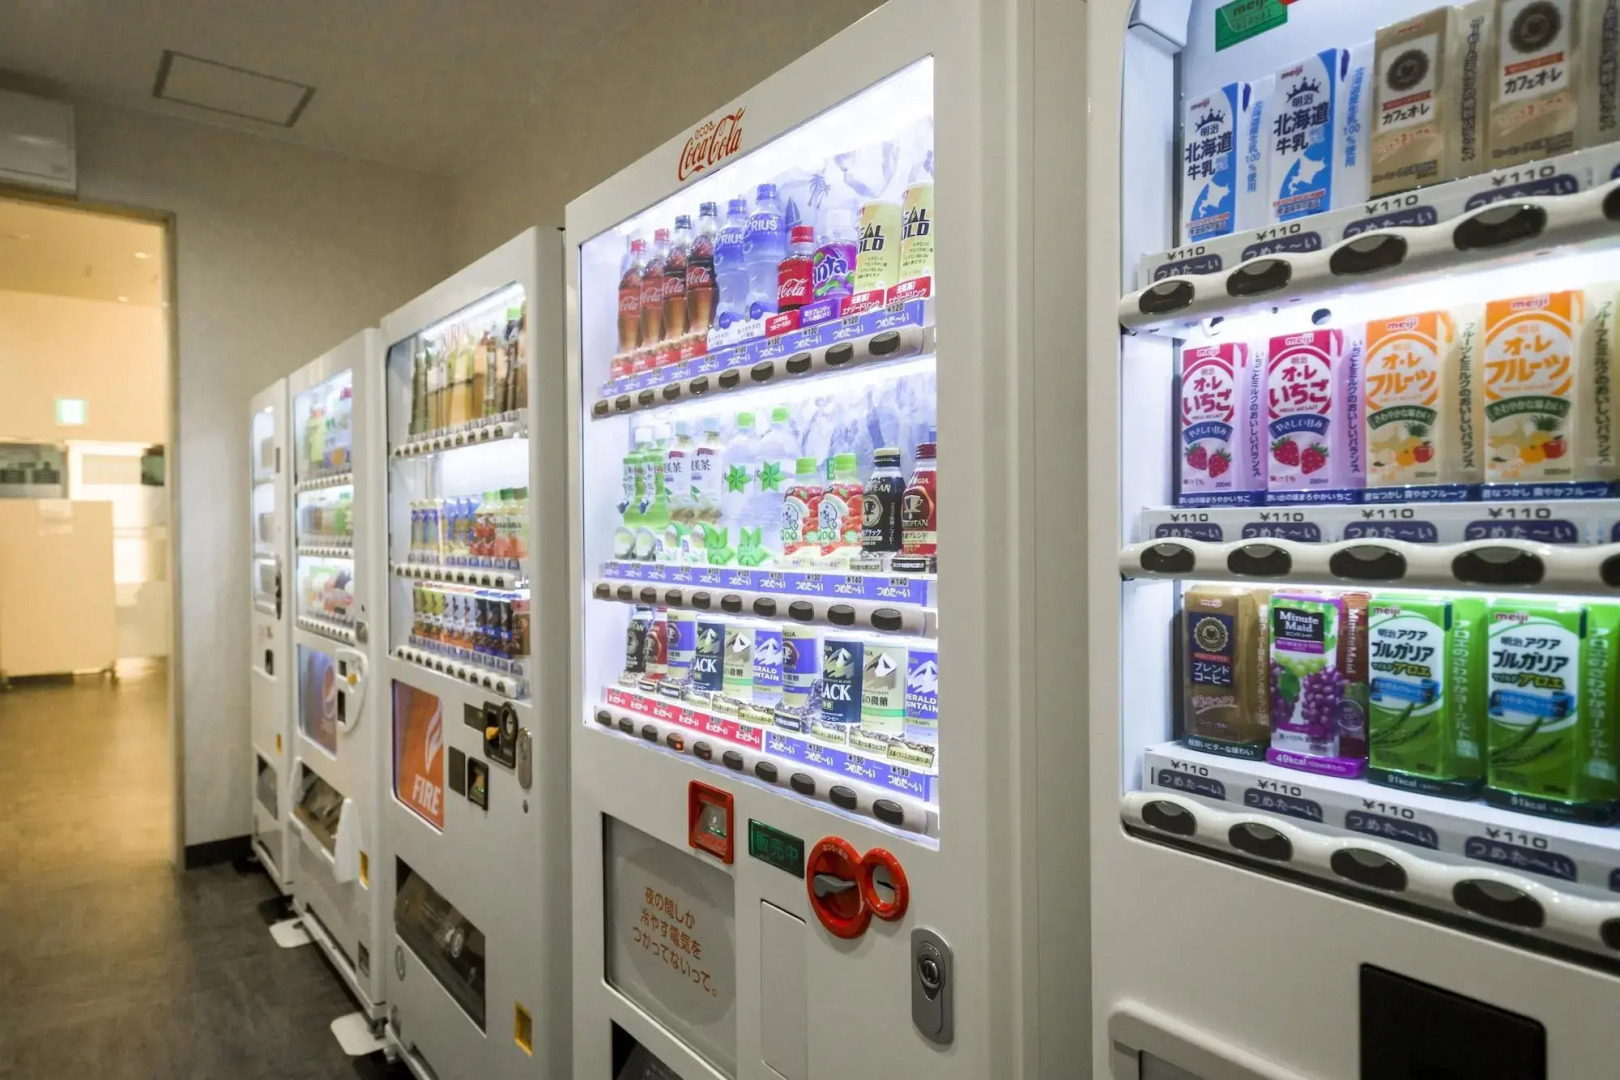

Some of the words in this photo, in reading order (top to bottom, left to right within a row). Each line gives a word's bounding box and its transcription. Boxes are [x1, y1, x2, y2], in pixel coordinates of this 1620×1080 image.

[1281, 65, 1304, 79] meiji
[1291, 93, 1314, 107] 明治
[1274, 101, 1330, 137] 北海道
[1200, 124, 1219, 137] 明治
[678, 105, 747, 181] Coca-Cola
[1185, 131, 1233, 164] 北海道
[1276, 137, 1309, 156] 牛乳
[1187, 159, 1216, 181] 牛乳
[1491, 164, 1556, 187] ¥110
[1364, 194, 1419, 215] ¥110
[1256, 223, 1301, 242] ¥110
[1167, 246, 1206, 261] ¥110
[687, 266, 711, 285] Cola
[662, 277, 685, 296] Cola
[777, 278, 809, 300] Cola
[620, 296, 640, 312] Cola
[1511, 296, 1550, 309] meiji
[875, 313, 910, 328] つめた～い
[1387, 318, 1419, 331] meiji
[833, 325, 864, 339] つめた～い
[1285, 333, 1314, 346] meiji
[794, 335, 822, 349] つめた～い
[1503, 335, 1552, 354] オ・レ
[1196, 345, 1220, 357] meiji
[1382, 353, 1422, 370] オ・レ
[1485, 354, 1570, 385] フルーツ
[1282, 365, 1318, 382] オ・レ
[1193, 376, 1223, 392] オ・レ
[1367, 370, 1437, 398] フルーツ
[1269, 379, 1330, 407] いちご
[1183, 389, 1232, 415] いちご
[1189, 424, 1228, 438] やさしい甘み
[1276, 418, 1323, 433] やさしい甘み
[1170, 513, 1209, 523] ¥110
[1258, 512, 1305, 523] ¥110
[1361, 508, 1415, 519] ¥110
[1488, 506, 1552, 520] ¥110
[795, 581, 823, 591] つめた～い
[834, 584, 865, 594] つめた～い
[876, 587, 911, 597] つめた～い
[1279, 610, 1320, 625] Minute
[1373, 606, 1401, 618] meiji
[1494, 611, 1529, 624] meiji
[1285, 621, 1314, 633] Maid
[1371, 641, 1434, 663] ブルガリア
[1193, 662, 1230, 675] ブレンド
[1492, 650, 1569, 673] ブルガリア
[1194, 672, 1231, 685] コーヒー
[805, 751, 834, 767] つめた～い
[1276, 754, 1307, 766] 49kcal
[844, 762, 876, 778] つめた～い
[1171, 760, 1209, 776] ¥110
[887, 775, 923, 792] つめた～い
[1162, 774, 1222, 794] つめた～い
[1256, 779, 1302, 797] ¥110
[412, 774, 441, 816] FIRE
[1247, 792, 1319, 817] つめた～い
[1362, 799, 1415, 819] ¥110
[1349, 815, 1434, 843] つめた～い
[1486, 827, 1549, 849] ¥110
[1469, 841, 1570, 874] つめた～い
[645, 886, 696, 930] 夜の間しか
[641, 907, 702, 961] 冷やす電気を
[632, 926, 718, 997] つかってないって。
